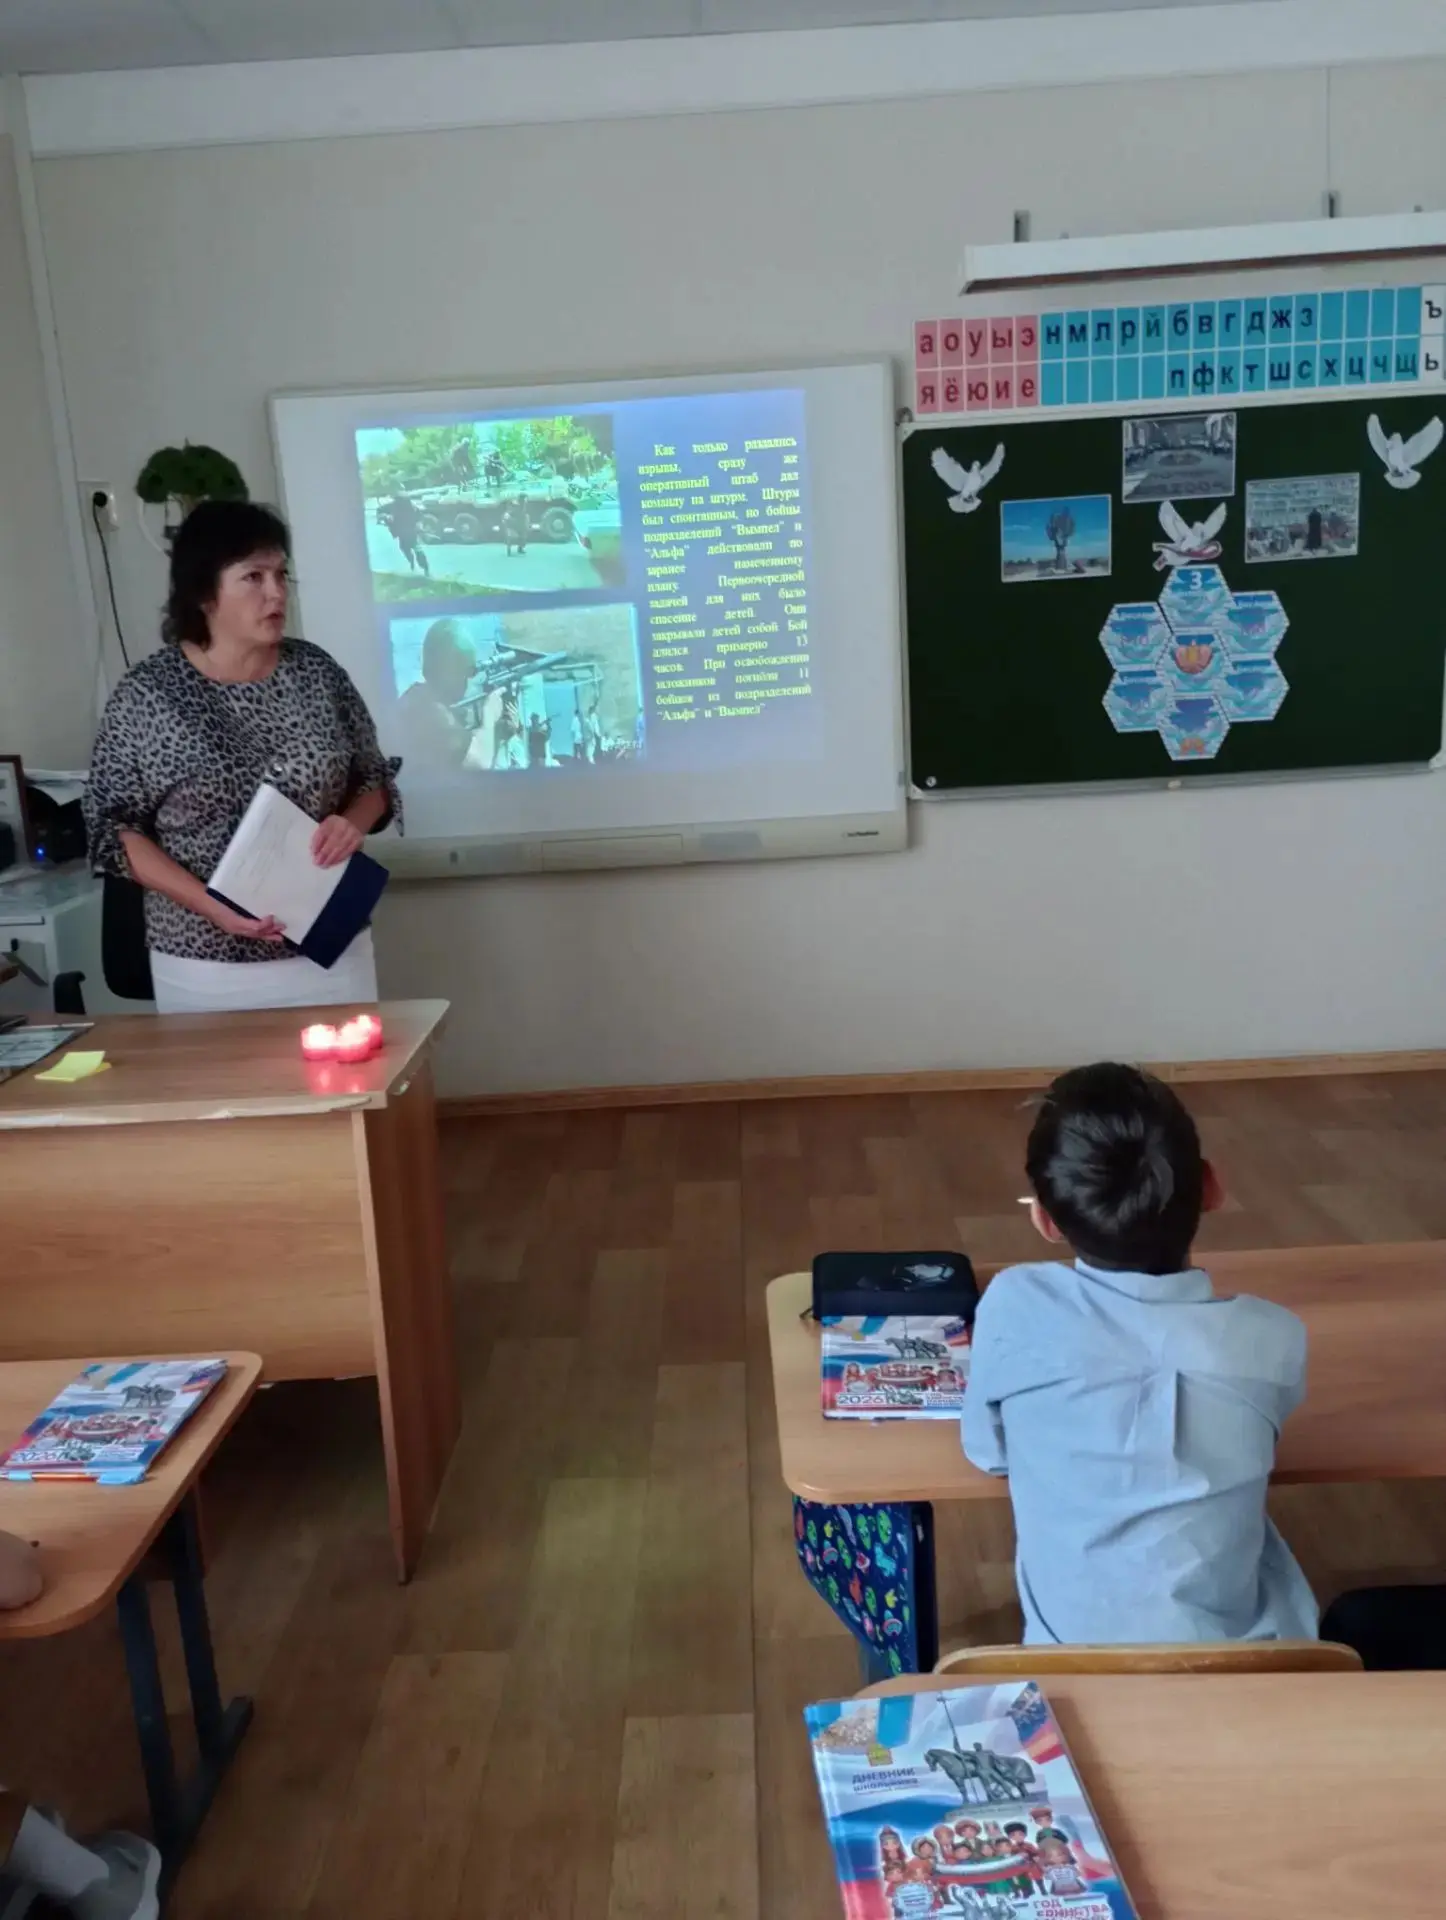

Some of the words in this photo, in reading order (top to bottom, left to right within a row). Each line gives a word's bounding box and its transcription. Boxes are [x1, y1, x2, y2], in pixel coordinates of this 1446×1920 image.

[920, 334, 933, 353] а
[944, 333, 959, 351] о
[968, 330, 982, 357] у
[992, 328, 1012, 348] ы
[1021, 327, 1034, 346] э
[1046, 325, 1060, 344] н
[1069, 324, 1087, 342] м
[1095, 322, 1110, 341] л
[1120, 320, 1135, 346] р
[1146, 313, 1160, 337] й
[1173, 309, 1189, 336] б
[1198, 314, 1212, 333] в
[1225, 312, 1236, 332] г
[1247, 310, 1264, 334] д
[1272, 309, 1291, 328] ж
[921, 385, 934, 404] я
[946, 378, 959, 403] ё
[968, 380, 988, 400] ю
[995, 379, 1008, 398] и
[1021, 378, 1035, 397] е
[1170, 368, 1184, 388] п
[1193, 361, 1214, 392] ф
[1220, 366, 1233, 384] к
[1245, 364, 1259, 383] т
[1270, 361, 1290, 381] ш
[1298, 360, 1312, 379] с
[1324, 358, 1337, 377] х
[1349, 356, 1364, 379] ц
[1374, 354, 1386, 373] ч
[1396, 353, 1416, 378] щ
[654, 444, 675, 456] Как
[692, 441, 728, 453] только
[638, 463, 681, 477] взрывы,
[718, 457, 746, 471] сразу
[784, 455, 797, 463] же
[640, 476, 709, 493] оперативный
[731, 472, 759, 485] штаб
[780, 471, 798, 482] дал
[641, 497, 684, 509] команду
[692, 496, 704, 504] на
[710, 493, 748, 505] штурм.
[762, 488, 799, 501] Штурм
[642, 514, 663, 525] был
[746, 509, 759, 518] но
[766, 505, 800, 516] бойцы
[644, 527, 722, 544] подразделений
[795, 522, 802, 531] и
[707, 541, 772, 555] действовали
[790, 539, 802, 548] по
[647, 565, 685, 577] заранее
[718, 570, 804, 588] Первоочередной
[1190, 570, 1202, 589] 3
[649, 596, 688, 608] задачей
[705, 595, 724, 605] для
[741, 592, 760, 602] них
[778, 587, 806, 599] было
[650, 614, 697, 625] спасение
[784, 604, 806, 615] Они
[712, 625, 740, 636] детей
[788, 620, 807, 631] Бой
[717, 640, 768, 654] примерно
[704, 658, 725, 671] При
[734, 654, 810, 668] освобождении
[656, 677, 716, 689] заложников
[735, 671, 778, 683] погибли
[708, 693, 720, 702] из
[735, 684, 812, 700] подразделений
[852, 1768, 915, 1784] ДНЕВНИК
[1034, 1900, 1061, 1908] ГОД
